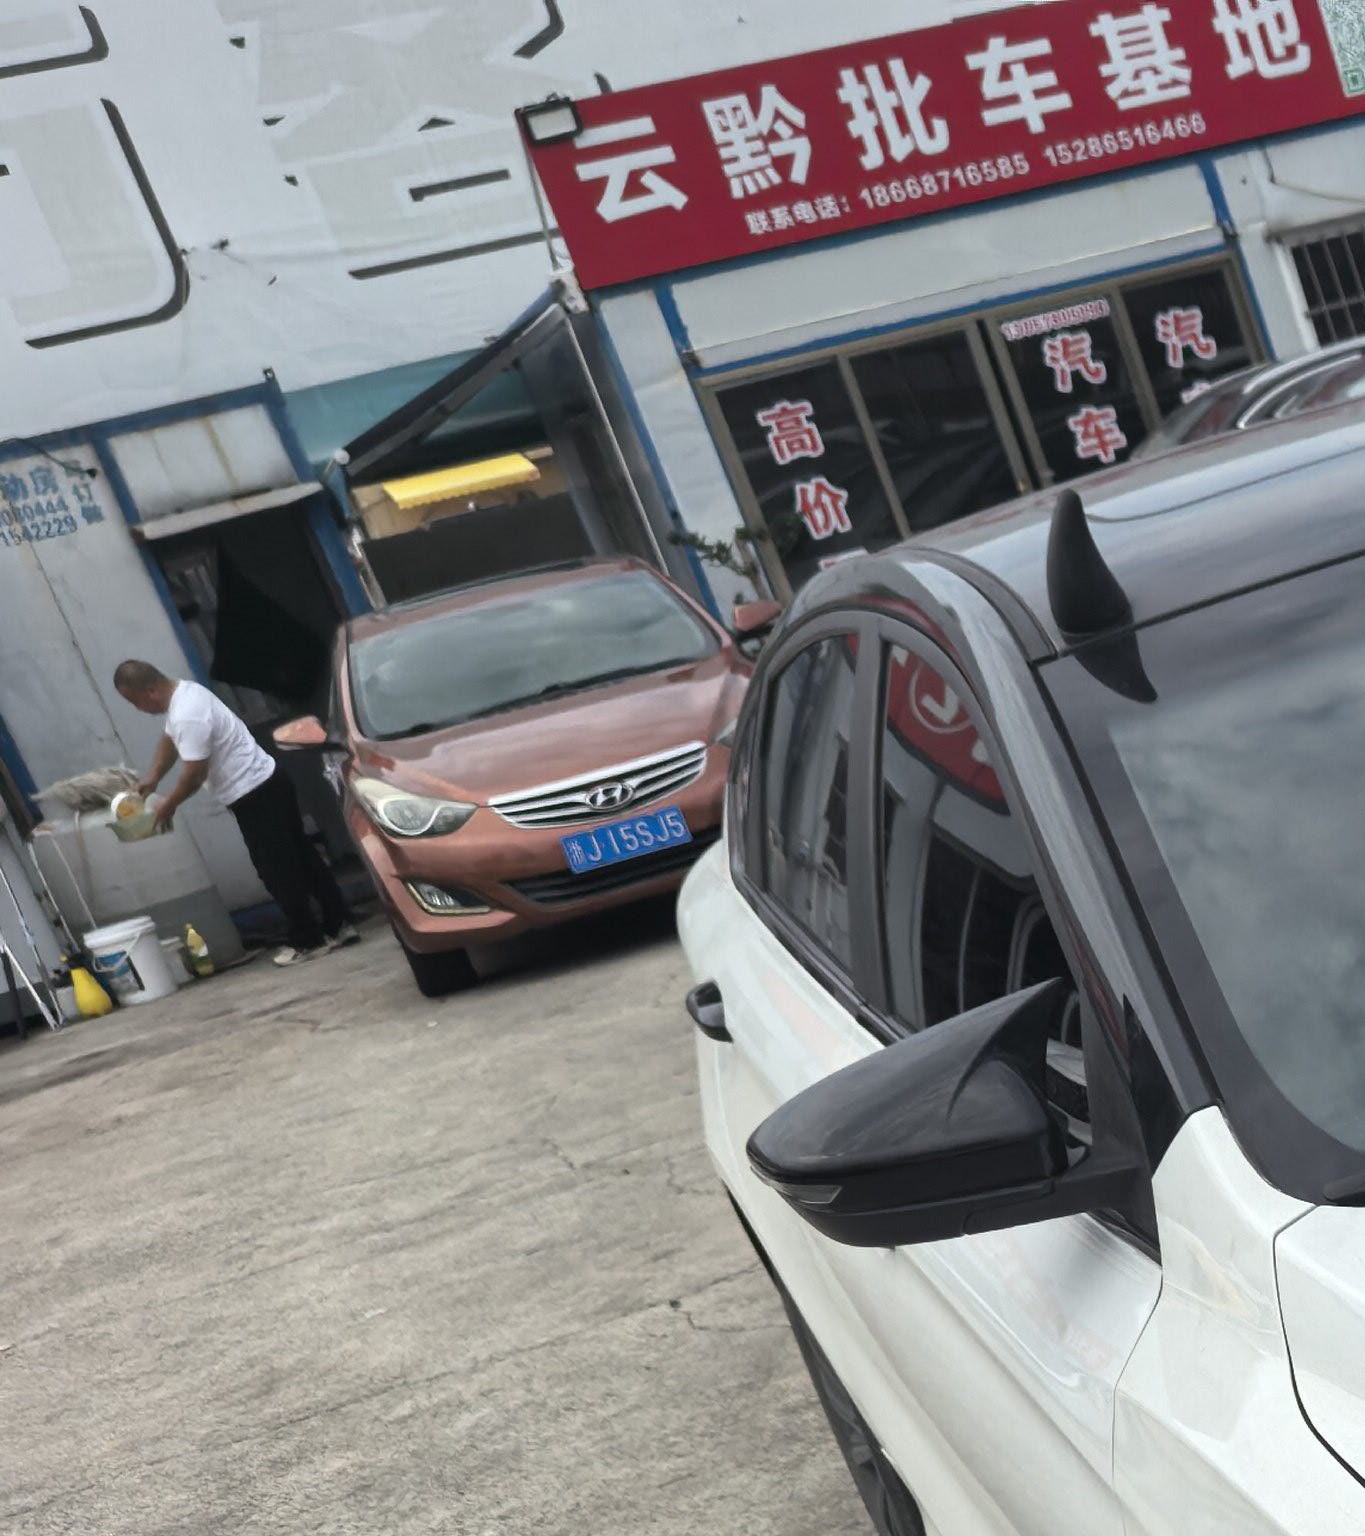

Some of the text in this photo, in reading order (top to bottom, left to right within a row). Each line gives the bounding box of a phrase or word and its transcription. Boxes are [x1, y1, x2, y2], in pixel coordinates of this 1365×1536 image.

[573, 0, 1312, 223] 云黔批车基地
[859, 151, 1030, 209] 18668716585
